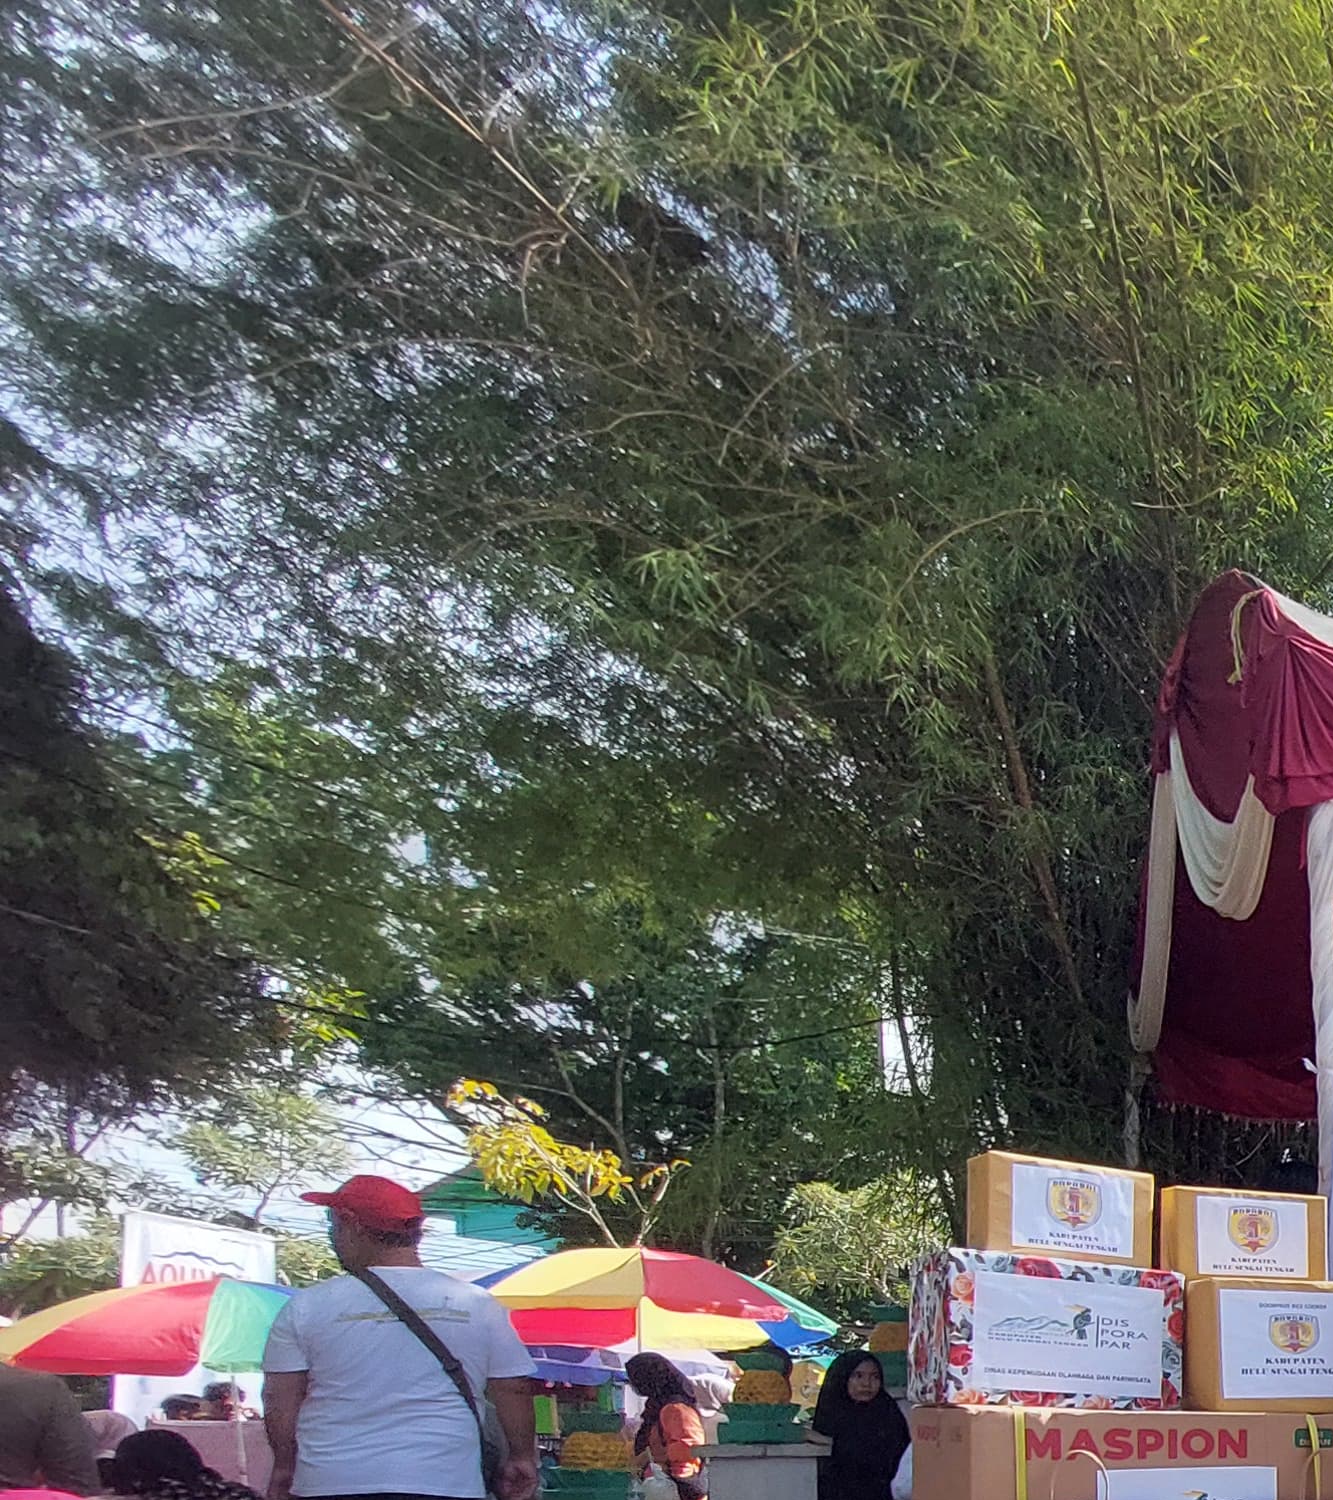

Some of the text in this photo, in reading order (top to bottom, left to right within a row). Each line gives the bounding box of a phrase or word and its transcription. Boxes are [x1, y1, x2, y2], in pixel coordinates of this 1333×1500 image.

[1049, 1231, 1100, 1243] KABUPATEN
[1231, 1256, 1277, 1266] KABUPATEN
[1101, 1317, 1129, 1328] DIS
[1100, 1329, 1148, 1341] PORA
[1100, 1341, 1132, 1351] PAR
[1265, 1357, 1325, 1366] KABUPATEN
[1024, 1427, 1249, 1462] MASPION
